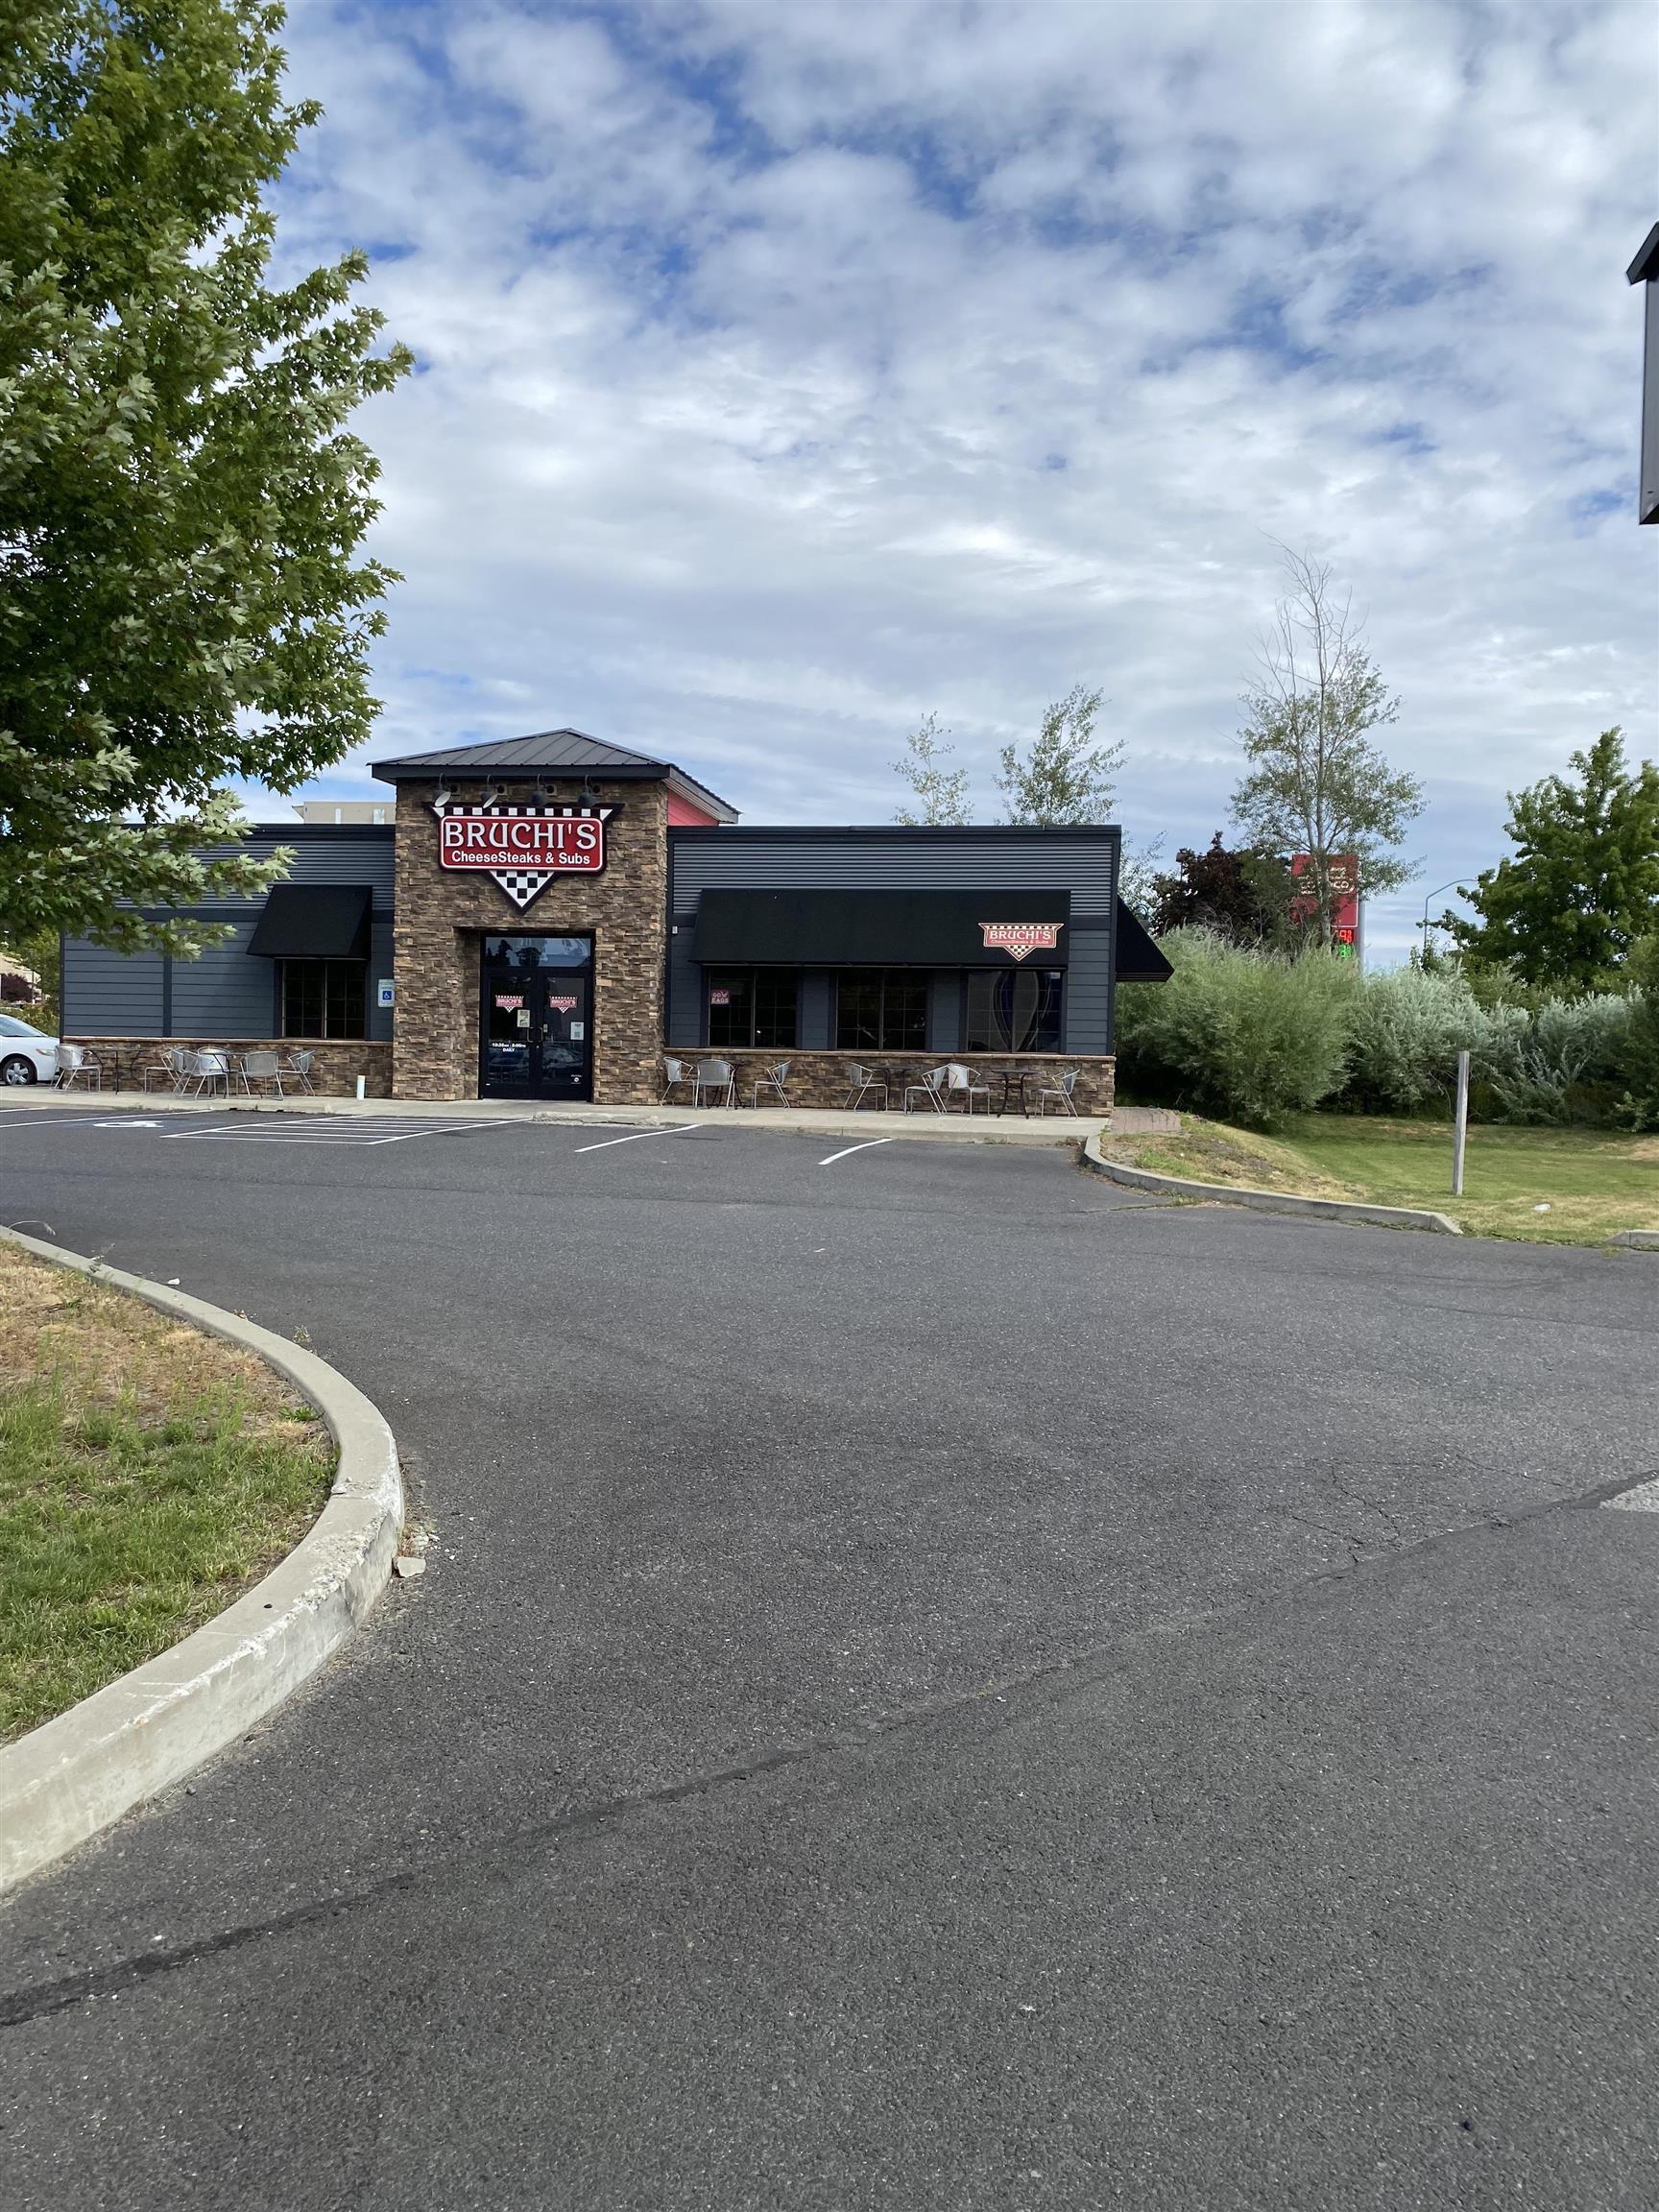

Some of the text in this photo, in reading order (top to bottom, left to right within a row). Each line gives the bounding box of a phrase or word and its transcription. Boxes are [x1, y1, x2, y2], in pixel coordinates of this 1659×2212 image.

[445, 822, 596, 850] BRUCHI'S
[451, 850, 590, 864] CheeseSteaks & Subs
[990, 930, 1051, 940] BRUCHI'S
